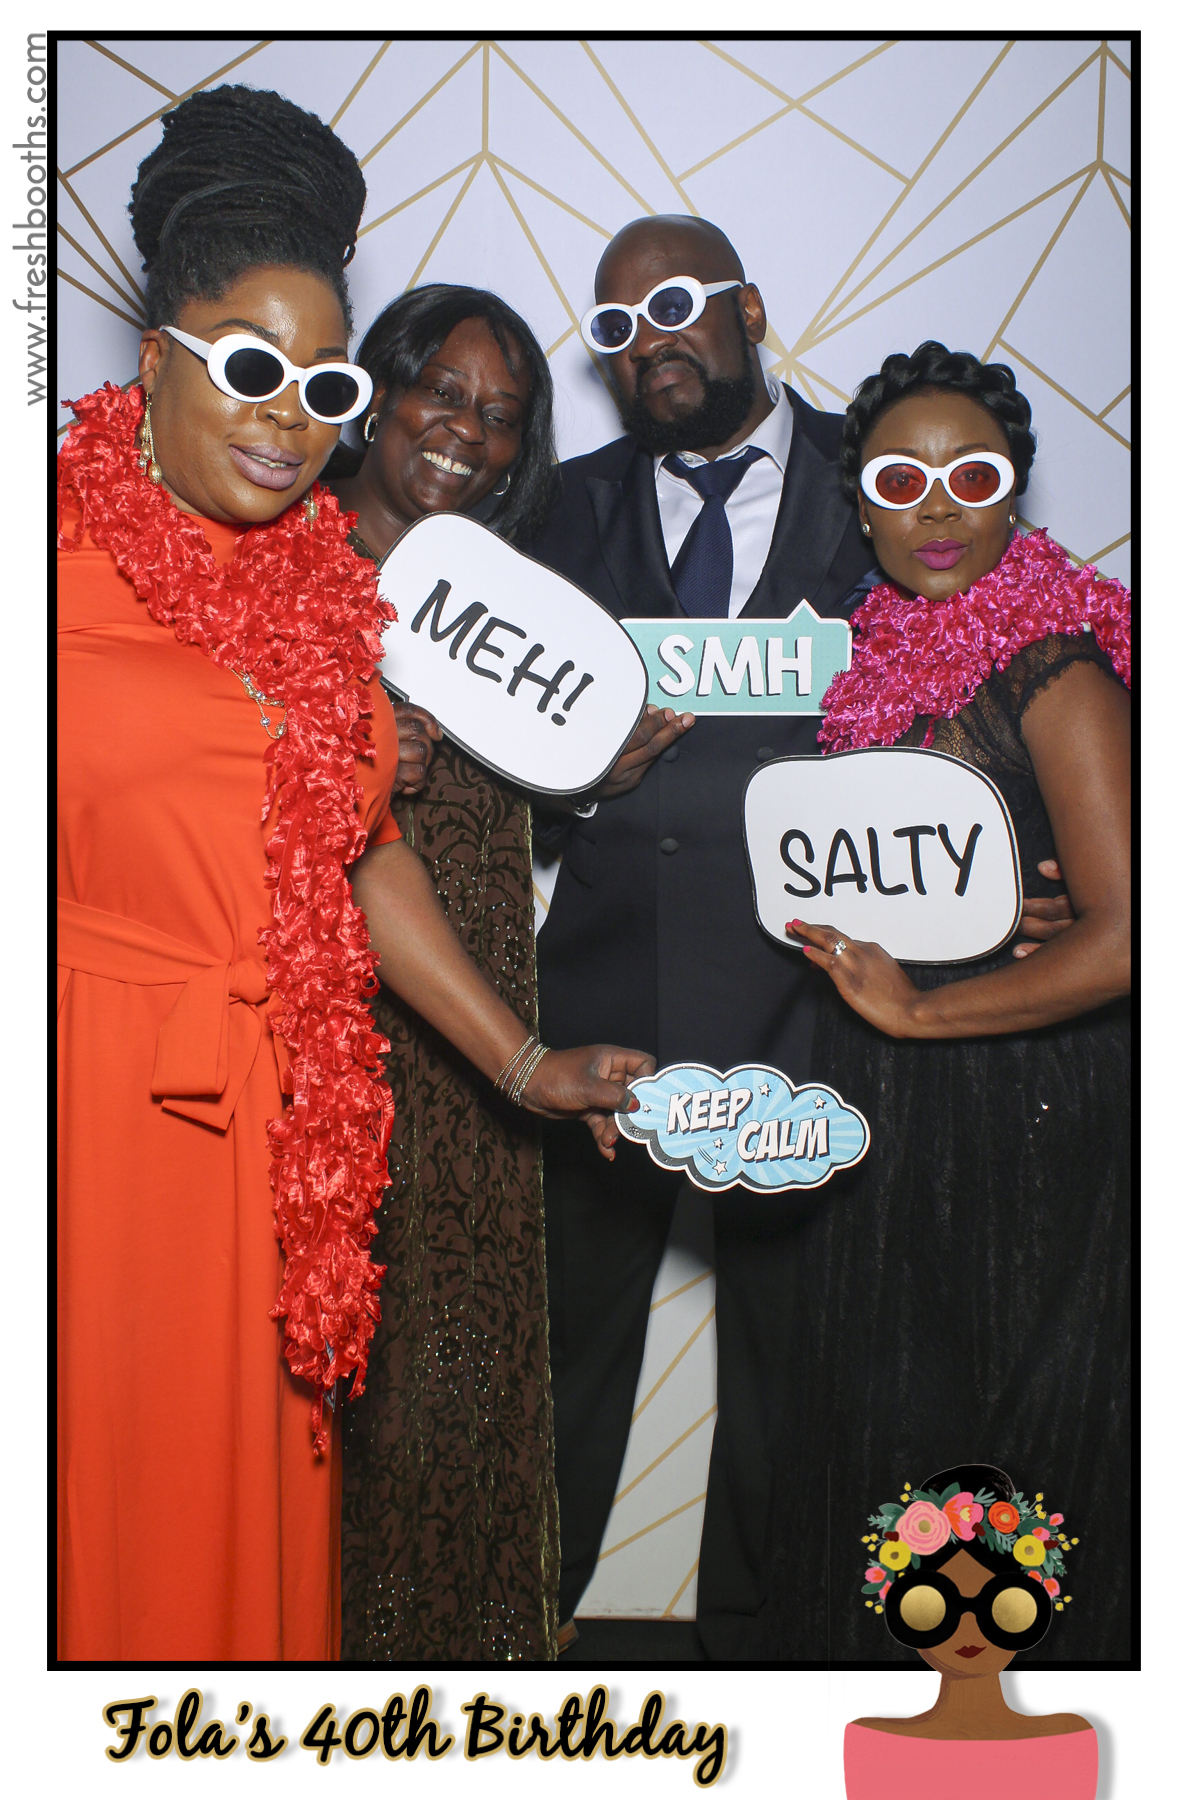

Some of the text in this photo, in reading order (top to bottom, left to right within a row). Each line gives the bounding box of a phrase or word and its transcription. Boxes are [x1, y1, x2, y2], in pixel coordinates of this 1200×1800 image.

[411, 579, 594, 726] MEH!
[657, 634, 812, 698] SMH
[779, 823, 982, 898] SALTY
[666, 1088, 753, 1135] KEEP
[737, 1116, 830, 1163] CALM
